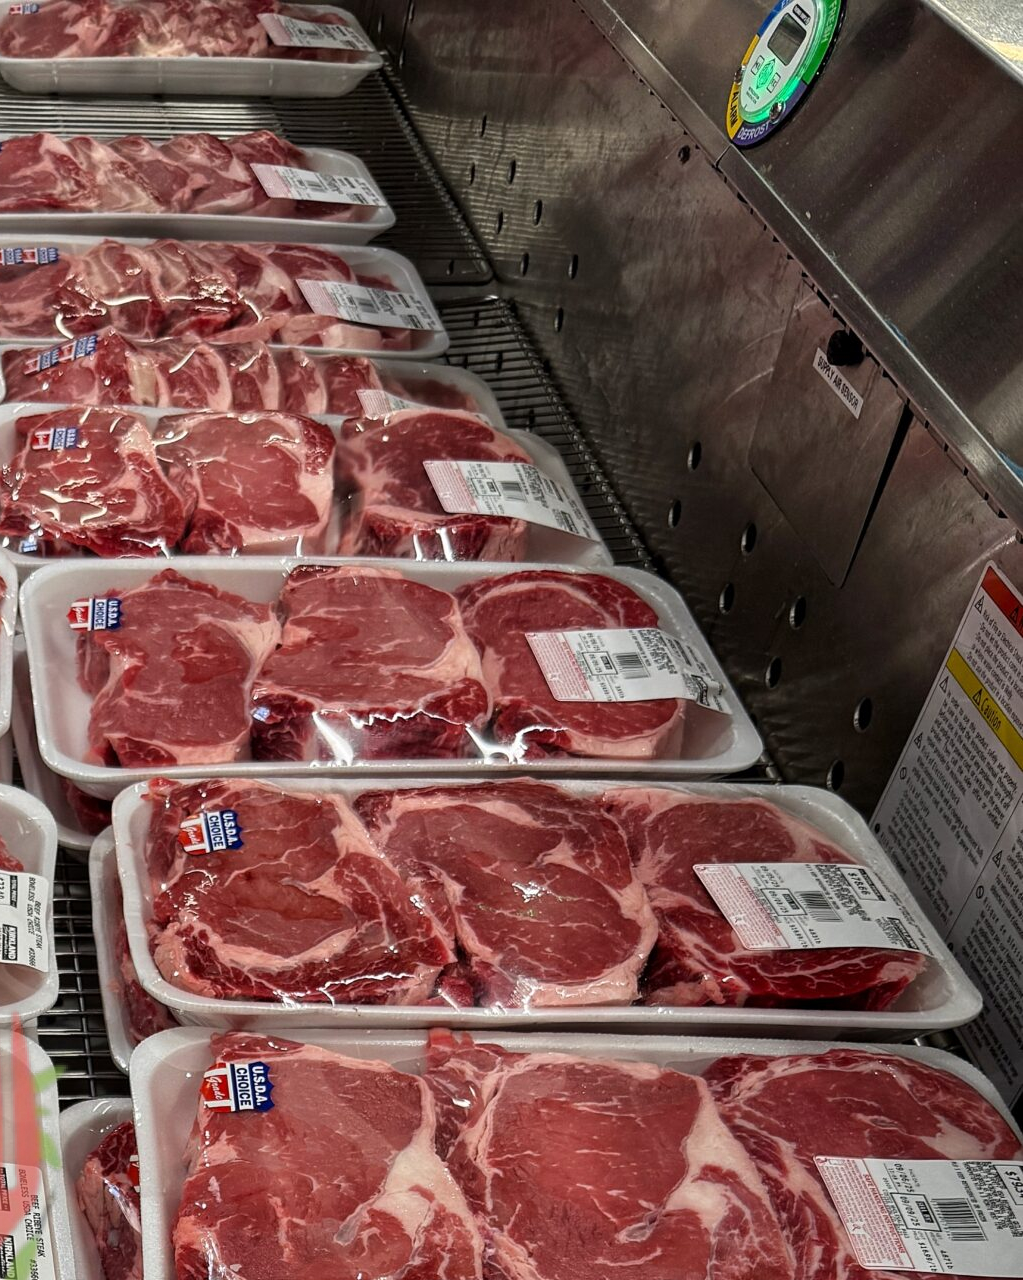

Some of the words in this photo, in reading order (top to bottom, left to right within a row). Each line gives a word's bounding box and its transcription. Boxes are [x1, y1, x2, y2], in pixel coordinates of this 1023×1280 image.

[731, 91, 739, 128] ALARM
[737, 123, 769, 140] DEFROST
[817, 356, 835, 380] SUPPLY
[833, 376, 843, 391] AIR
[841, 384, 859, 410] SENSOR
[96, 602, 105, 628] CHOICE
[980, 697, 1002, 731] Caution
[209, 815, 223, 847] CHOICE
[223, 813, 238, 845] U.S.D.A.
[8, 926, 16, 959] KIRKLAND
[206, 1076, 225, 1100] Grade
[236, 1067, 251, 1106] CHOICE
[252, 1066, 267, 1106] U.S.D.A.
[18, 1168, 29, 1198] BONELESS
[22, 1200, 31, 1216] USDA
[30, 1194, 40, 1209] BEEF
[24, 1218, 35, 1241] CHOICE
[32, 1212, 43, 1235] RIBEYE
[3, 1236, 15, 1278] KIRKLAND
[35, 1237, 46, 1258] STEAK
